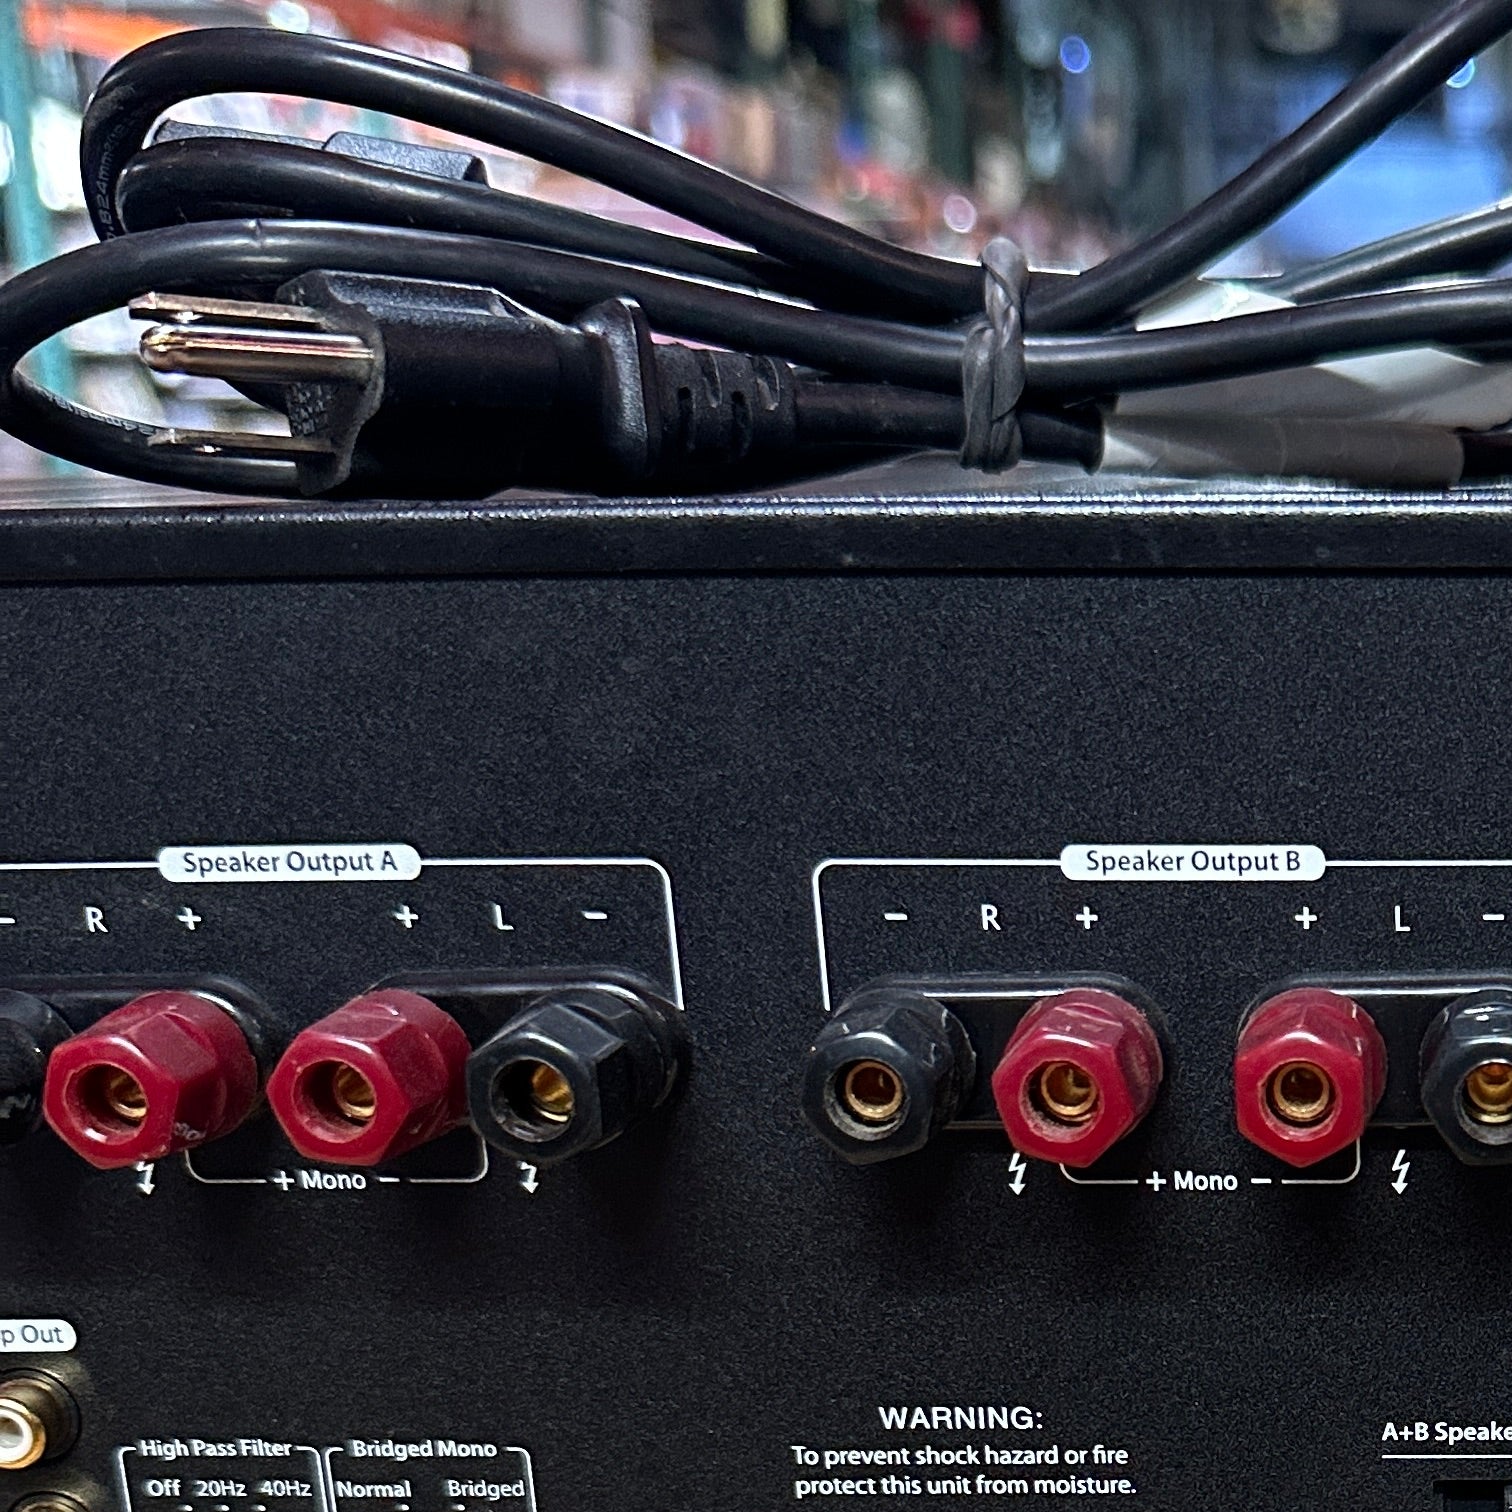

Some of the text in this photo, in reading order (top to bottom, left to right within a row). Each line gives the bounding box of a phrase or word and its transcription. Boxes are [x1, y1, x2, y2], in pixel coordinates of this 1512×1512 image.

[183, 850, 398, 876] Speaker Output A
[1086, 849, 1301, 876] Speaker Output B
[84, 906, 109, 933] R
[493, 903, 514, 931] L
[980, 903, 1002, 931] R
[1394, 905, 1411, 932] L
[299, 1169, 367, 1190] Mono
[1173, 1170, 1238, 1191] Mono
[20, 1324, 64, 1344] Out
[878, 1406, 1043, 1430] WARNING:
[1381, 1421, 1430, 1442] A+B
[139, 1438, 293, 1461] High Pass Filter
[350, 1439, 498, 1461] Bridged Mono
[790, 1444, 1129, 1470] To prevent shock hazard or fire
[145, 1478, 313, 1497] Off 20Hz 40Hz
[335, 1479, 526, 1501] Normal Bridged
[794, 1473, 1137, 1499] protect this unit from moisture.
